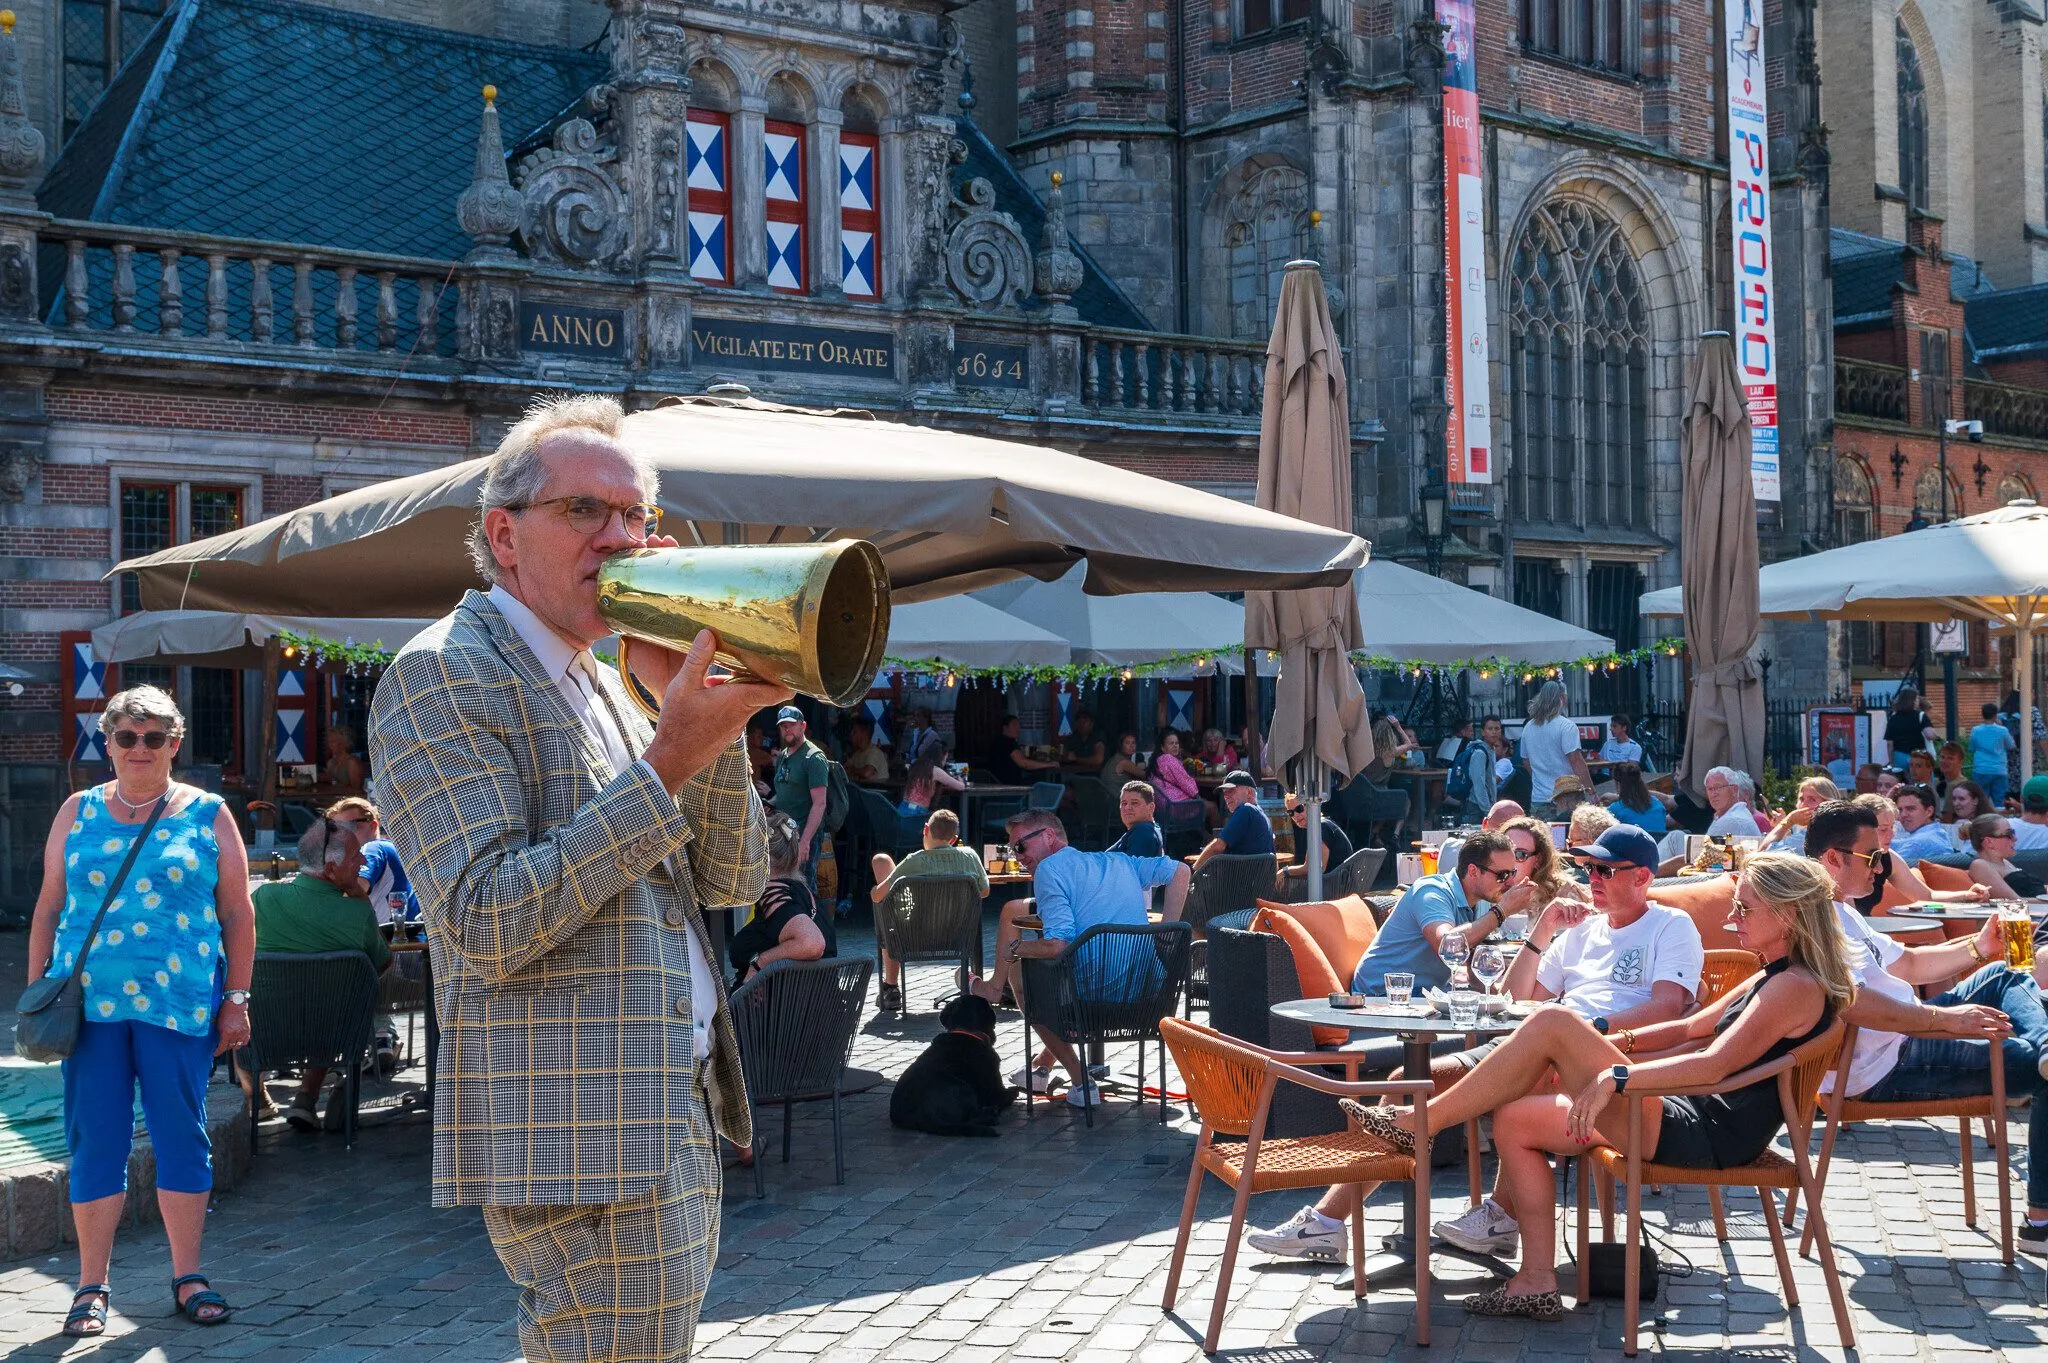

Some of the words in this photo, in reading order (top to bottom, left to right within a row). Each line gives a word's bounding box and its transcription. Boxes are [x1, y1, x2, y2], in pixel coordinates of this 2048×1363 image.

[1445, 107, 1473, 134] lier,
[530, 313, 614, 347] ANNO
[789, 341, 814, 362] ET
[818, 340, 888, 367] ORATE
[1446, 363, 1457, 421] gootste
[1749, 386, 1765, 396] LAAT
[1447, 425, 1456, 449] het
[1752, 441, 1776, 452] UGUSTUS
[1450, 452, 1459, 472] op
